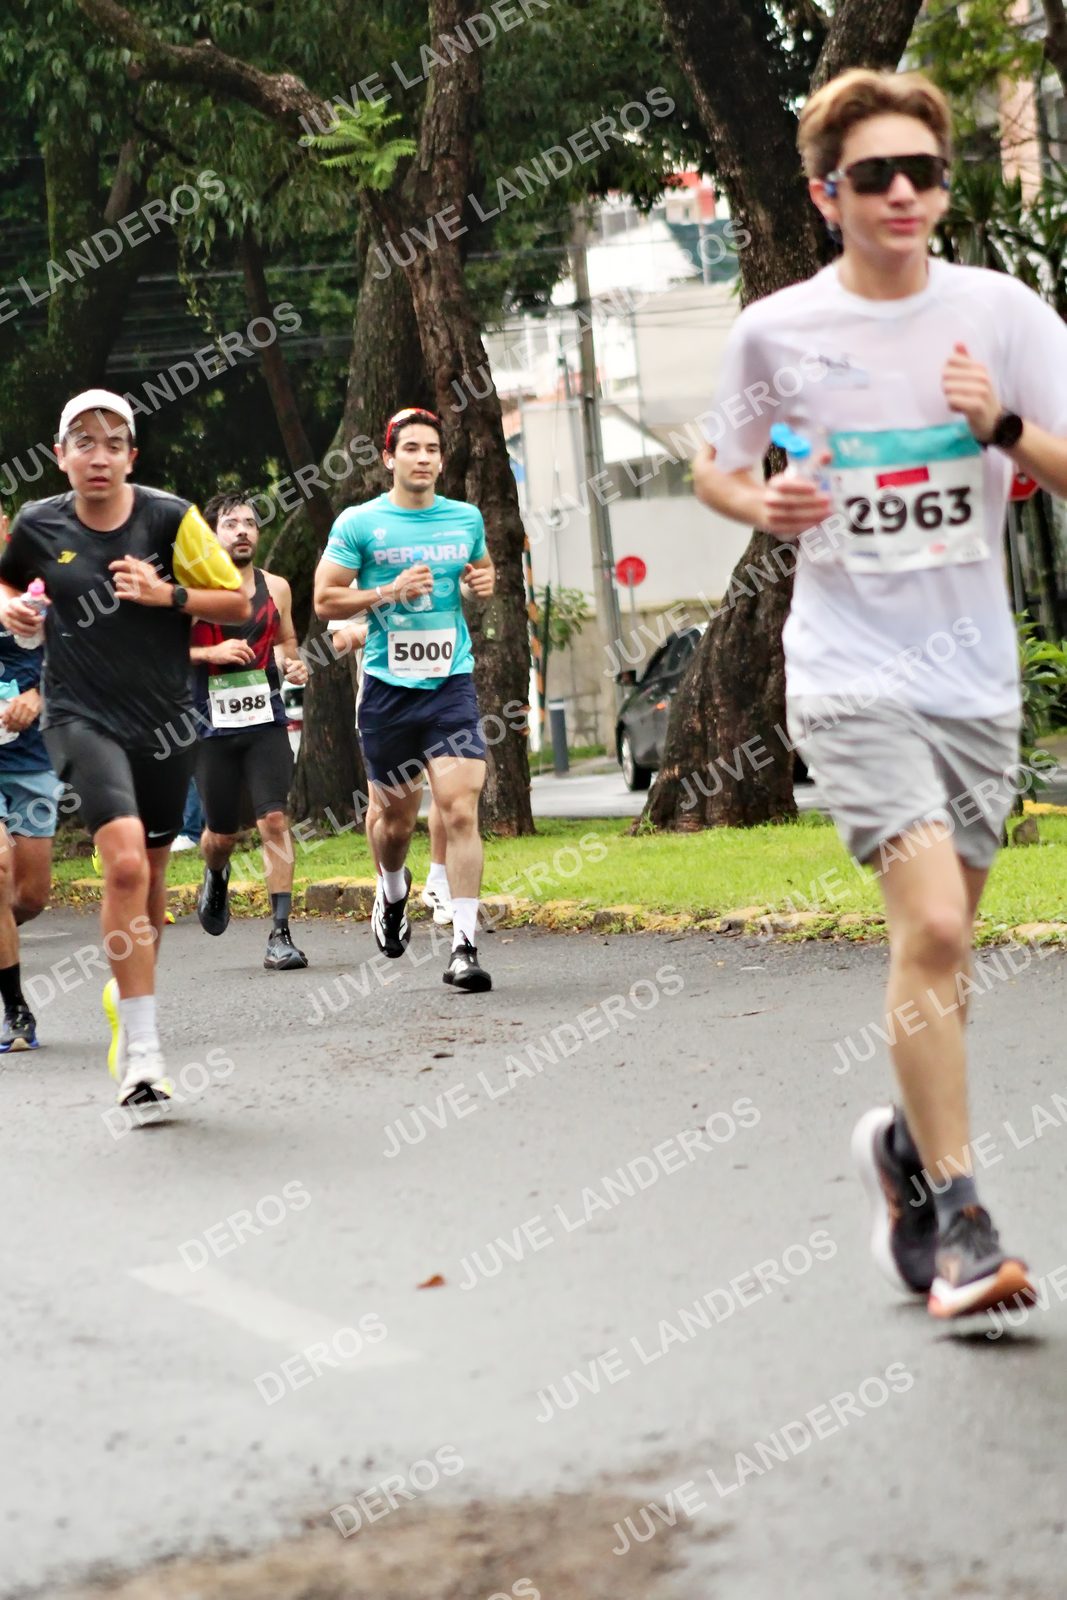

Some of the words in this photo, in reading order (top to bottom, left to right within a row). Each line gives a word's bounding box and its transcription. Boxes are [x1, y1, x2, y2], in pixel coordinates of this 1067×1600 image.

[844, 486, 972, 536] 2963
[393, 641, 453, 661] 5000
[215, 695, 266, 714] 1988
